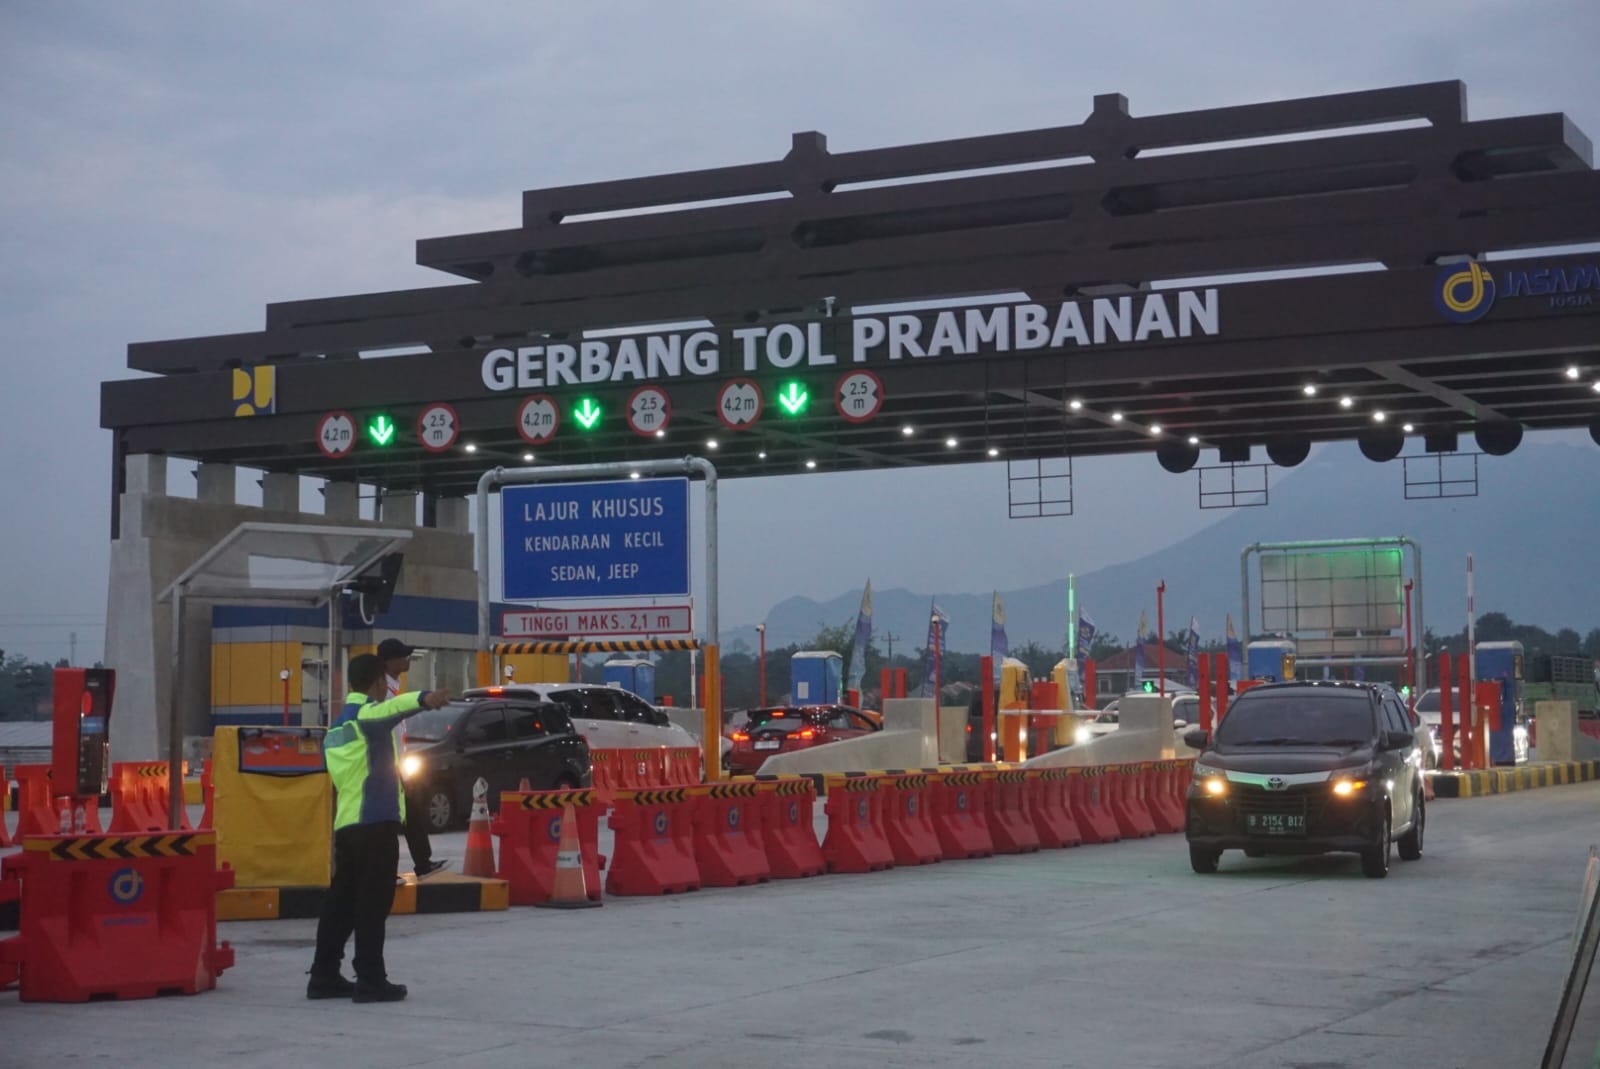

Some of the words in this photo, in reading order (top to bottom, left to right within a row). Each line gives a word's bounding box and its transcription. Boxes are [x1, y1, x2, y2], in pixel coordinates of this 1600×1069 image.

[481, 331, 720, 392] GERBANG
[732, 322, 837, 371] TOL
[852, 287, 1220, 362] PRAMBANAN
[850, 381, 868, 395] 2.5
[641, 398, 657, 411] 2.5
[724, 398, 742, 411] 4.2
[743, 399, 755, 410] m
[854, 398, 865, 409] m
[430, 415, 446, 427] 2.5
[524, 413, 540, 427] 4.2
[542, 414, 553, 425] m
[643, 413, 655, 424] m
[324, 428, 339, 442] 4.2
[340, 430, 350, 441] m
[433, 430, 443, 441] m
[524, 501, 580, 522] LAJUR
[592, 496, 664, 519] KHUSUS
[524, 533, 611, 552] KENDARAAN
[624, 531, 665, 548] KECIL
[551, 564, 601, 582] SEDAN,
[607, 563, 639, 580] JEEP
[520, 615, 569, 632] TINGGI
[578, 614, 625, 631] MAKS.
[657, 615, 671, 629] m
